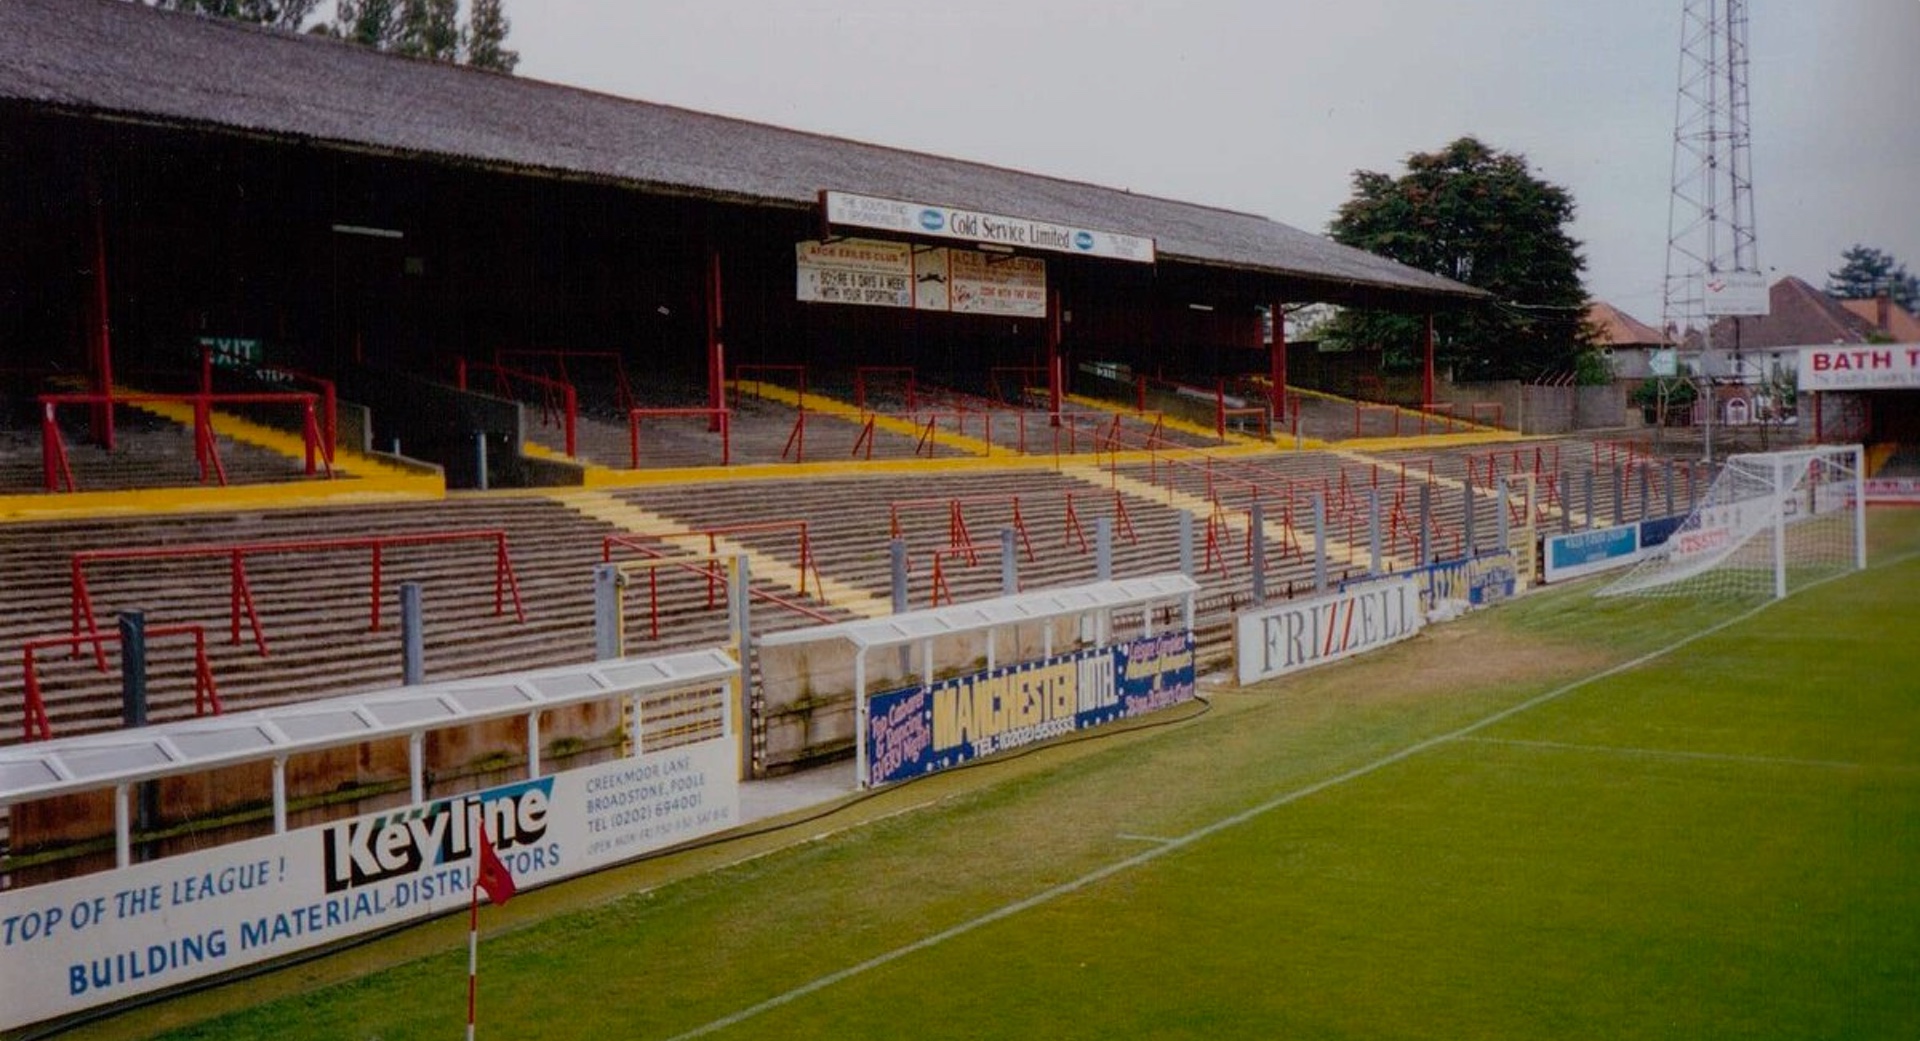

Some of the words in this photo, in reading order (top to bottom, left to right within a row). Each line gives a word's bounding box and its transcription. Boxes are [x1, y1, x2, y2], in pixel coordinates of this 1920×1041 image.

[950, 212, 977, 237] Cold
[982, 216, 1024, 243] Service
[1029, 224, 1069, 248] Limited
[200, 338, 256, 364] EXIT
[1813, 349, 1891, 371] BATH
[1260, 586, 1413, 672] FRIZZELL
[933, 661, 1077, 752] MANCHESTER
[1077, 651, 1118, 713] HOTEL
[587, 764, 660, 793] CREEKMOOR
[664, 756, 690, 775] LANE
[587, 784, 669, 814] BROADSTONE,
[671, 772, 705, 795] POOLE
[588, 818, 607, 833] TEL
[611, 804, 652, 827] (0202)
[655, 793, 702, 817] 694001
[323, 787, 549, 894] Keyline
[3, 907, 63, 946] TOP
[70, 897, 105, 930] OF
[114, 884, 162, 919] THE
[69, 929, 227, 996] BUILDING
[240, 889, 386, 950] MATERIAL
[396, 843, 560, 908] DISTRITORS
